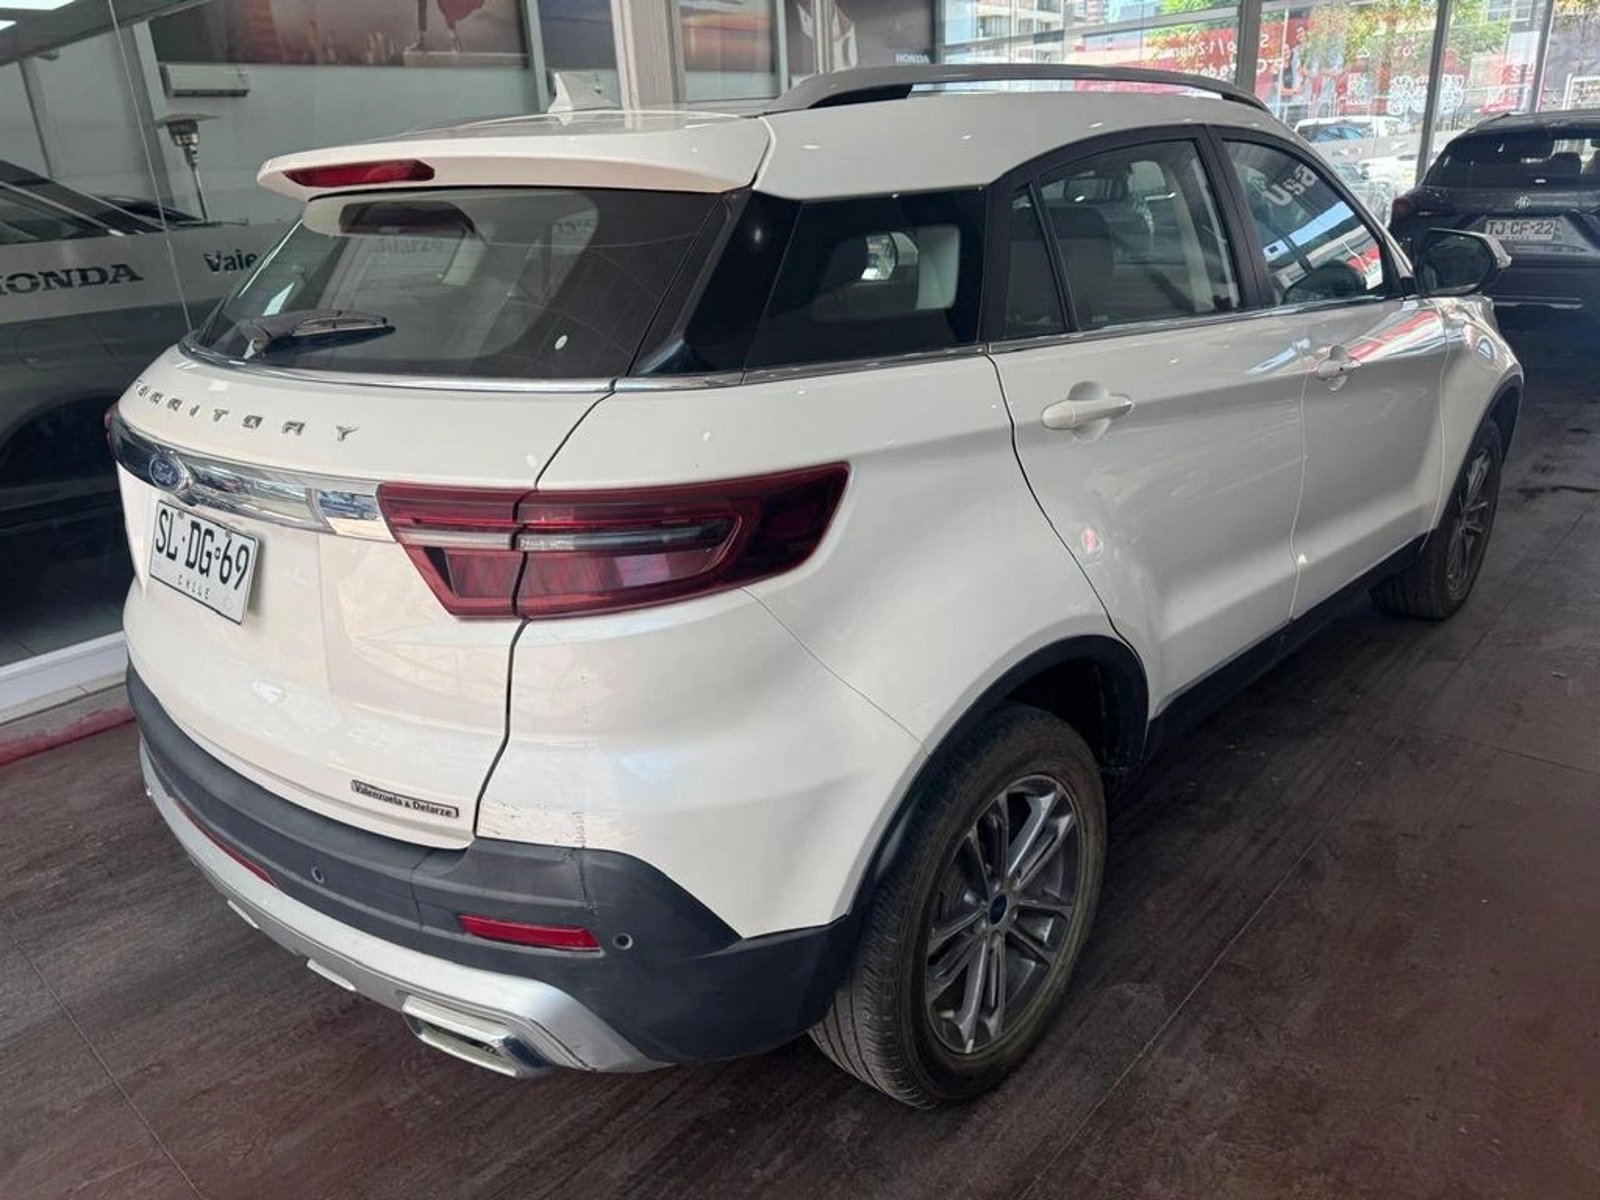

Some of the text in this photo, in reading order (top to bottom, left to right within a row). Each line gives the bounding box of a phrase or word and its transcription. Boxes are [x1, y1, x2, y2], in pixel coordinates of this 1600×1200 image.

[0, 263, 144, 296] ONDA
[353, 781, 403, 806] Valenzuela
[412, 800, 453, 817] Delarze
